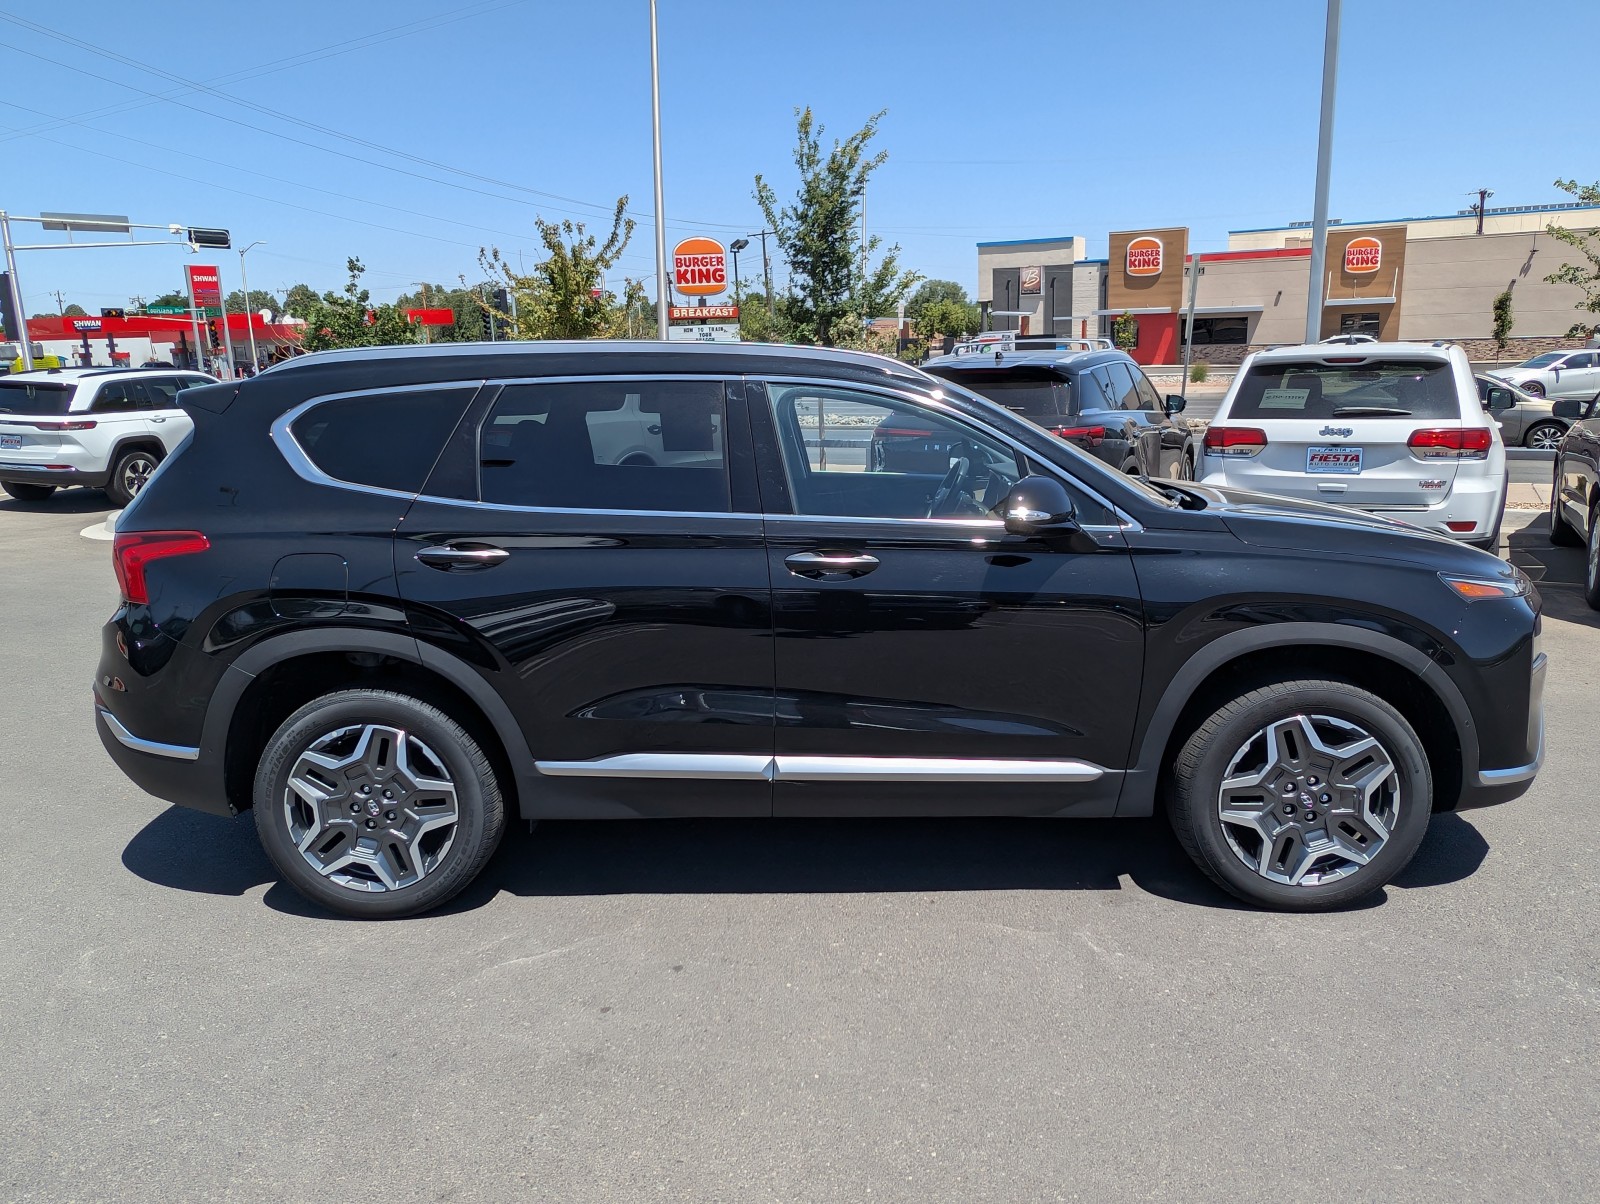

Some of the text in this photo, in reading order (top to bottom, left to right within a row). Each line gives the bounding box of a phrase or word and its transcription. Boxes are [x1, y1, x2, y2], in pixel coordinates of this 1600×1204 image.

[1128, 249, 1161, 258] BURGER
[1347, 248, 1379, 256] BURGER
[675, 256, 724, 268] BURGER
[1128, 257, 1161, 268] KING
[1346, 256, 1379, 266] KING
[676, 268, 725, 284] KING
[673, 308, 734, 317] BREAKFAST
[1319, 425, 1354, 438] Jeep
[1309, 453, 1360, 462] FIESTA
